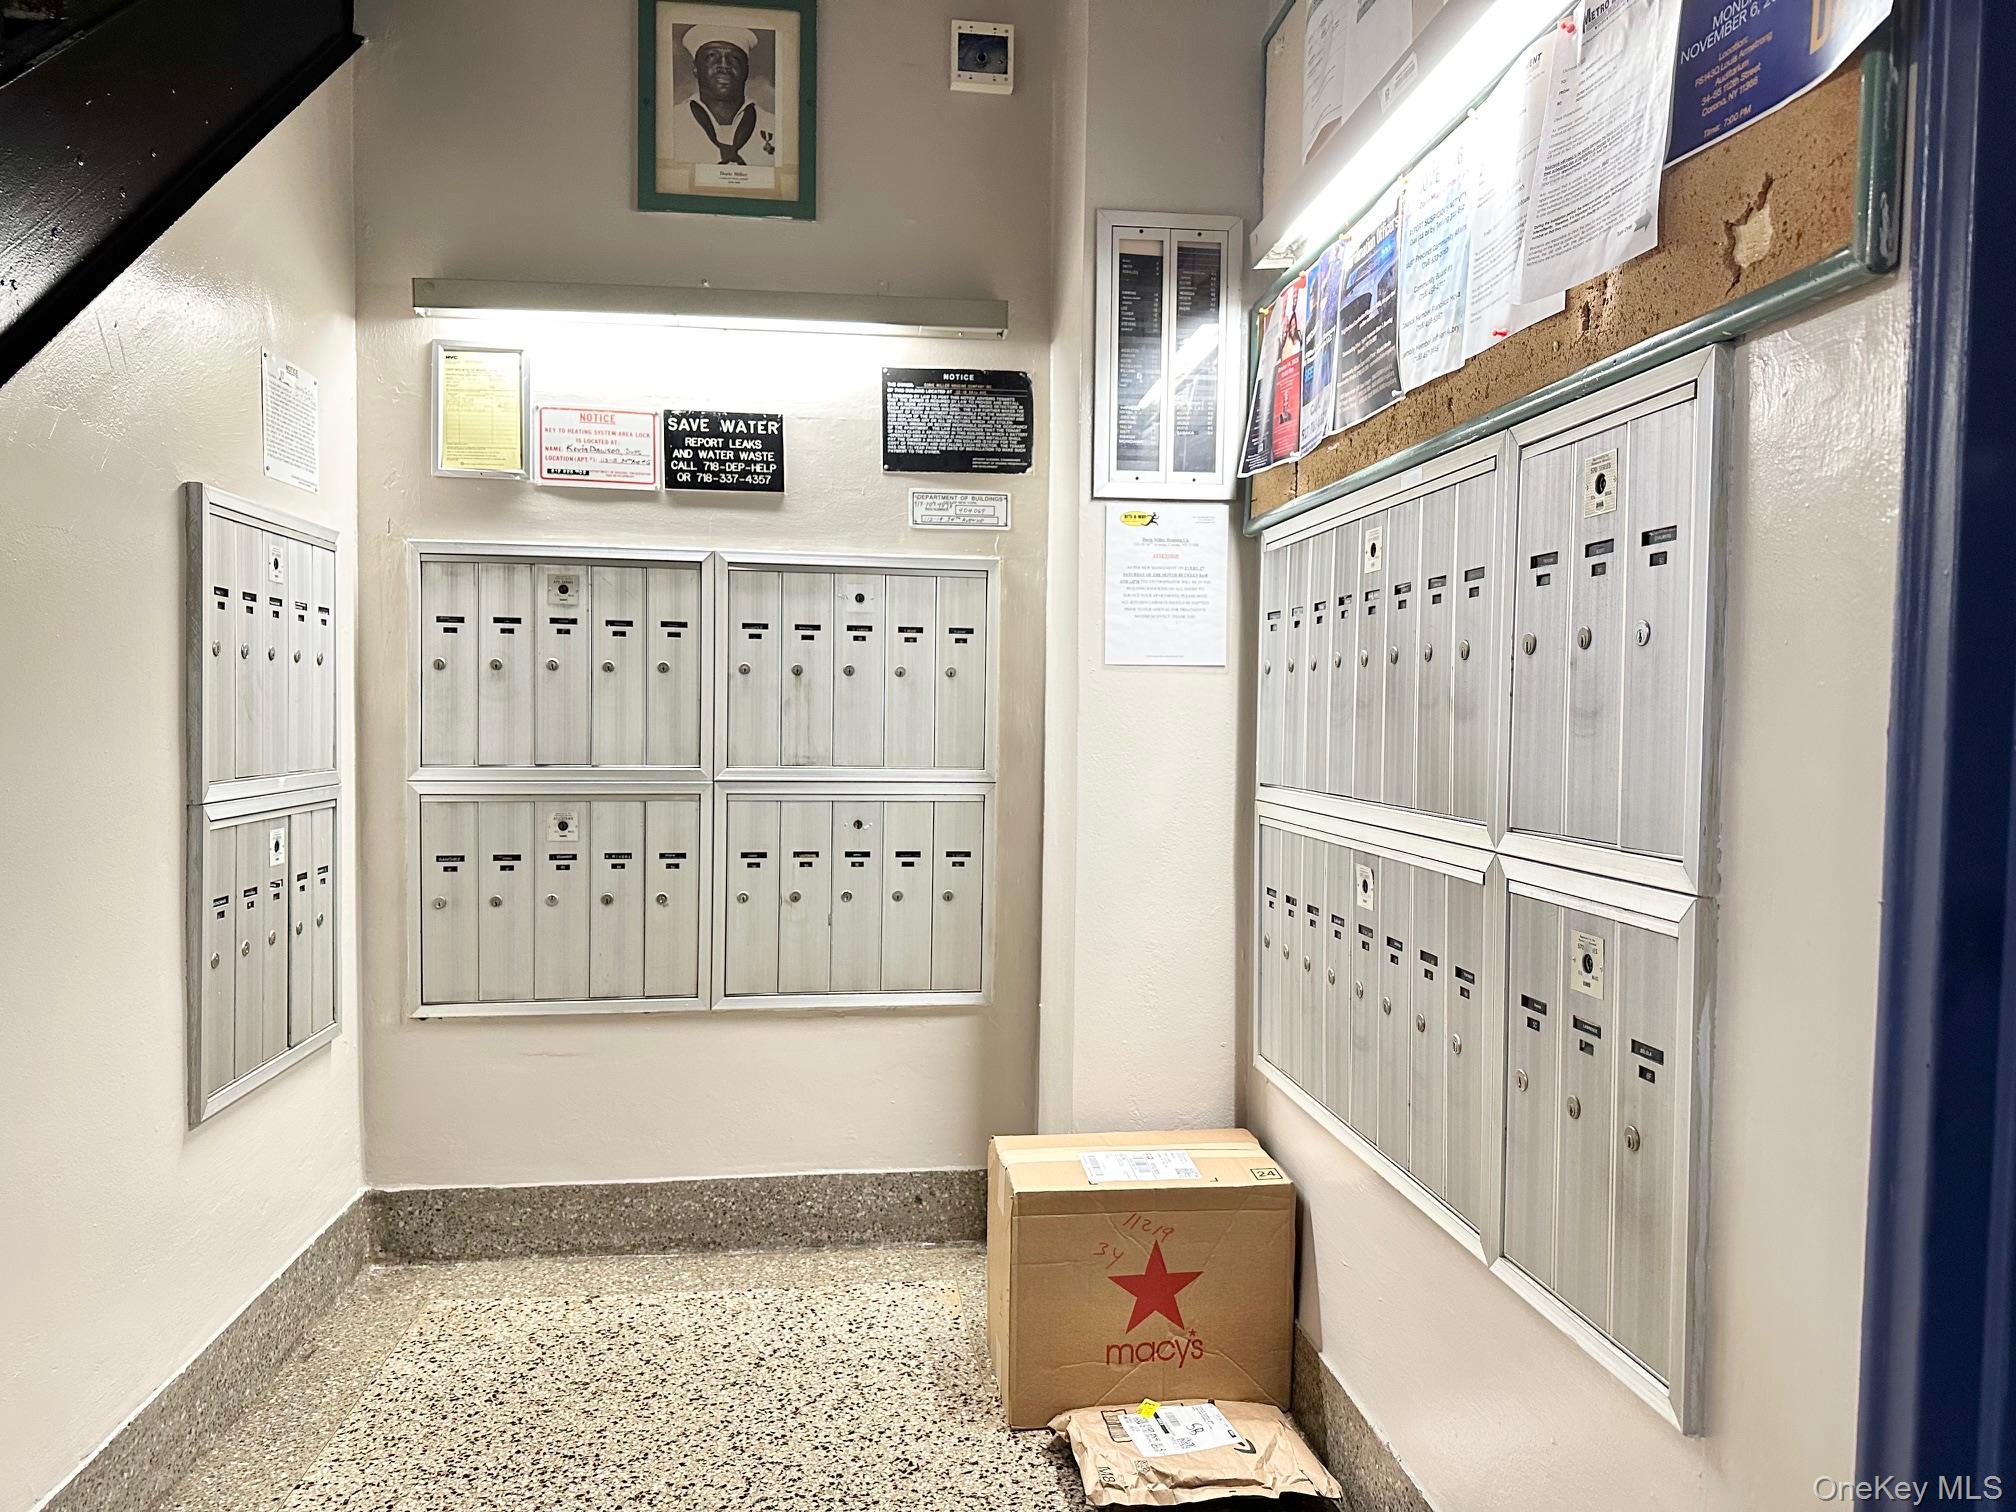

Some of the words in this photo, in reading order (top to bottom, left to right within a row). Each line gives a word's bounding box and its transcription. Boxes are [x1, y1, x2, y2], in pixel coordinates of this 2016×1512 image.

[1712, 0, 1751, 30] MOND
[1681, 9, 1747, 64] NOVEMBER
[1749, 1, 1760, 17] 6,
[1715, 59, 1750, 87] Auditorium
[1740, 62, 1761, 82] Street
[1739, 104, 1752, 118] PM
[580, 413, 616, 422] NOTICE
[668, 418, 710, 432] SAVE
[720, 419, 779, 434] WATER
[566, 444, 588, 453] Kevin
[685, 437, 724, 448] REPORT
[729, 439, 762, 449] LEAKS
[673, 449, 693, 458] AND
[698, 450, 734, 460] WATER
[739, 451, 774, 461] WASTE
[671, 461, 697, 470] CALL
[704, 462, 777, 473] 718-DEP-HELP
[677, 473, 691, 482] OR
[696, 473, 771, 484] 718-337-4357
[1256, 1169, 1276, 1178] 24
[1122, 1213, 1175, 1242] 11219
